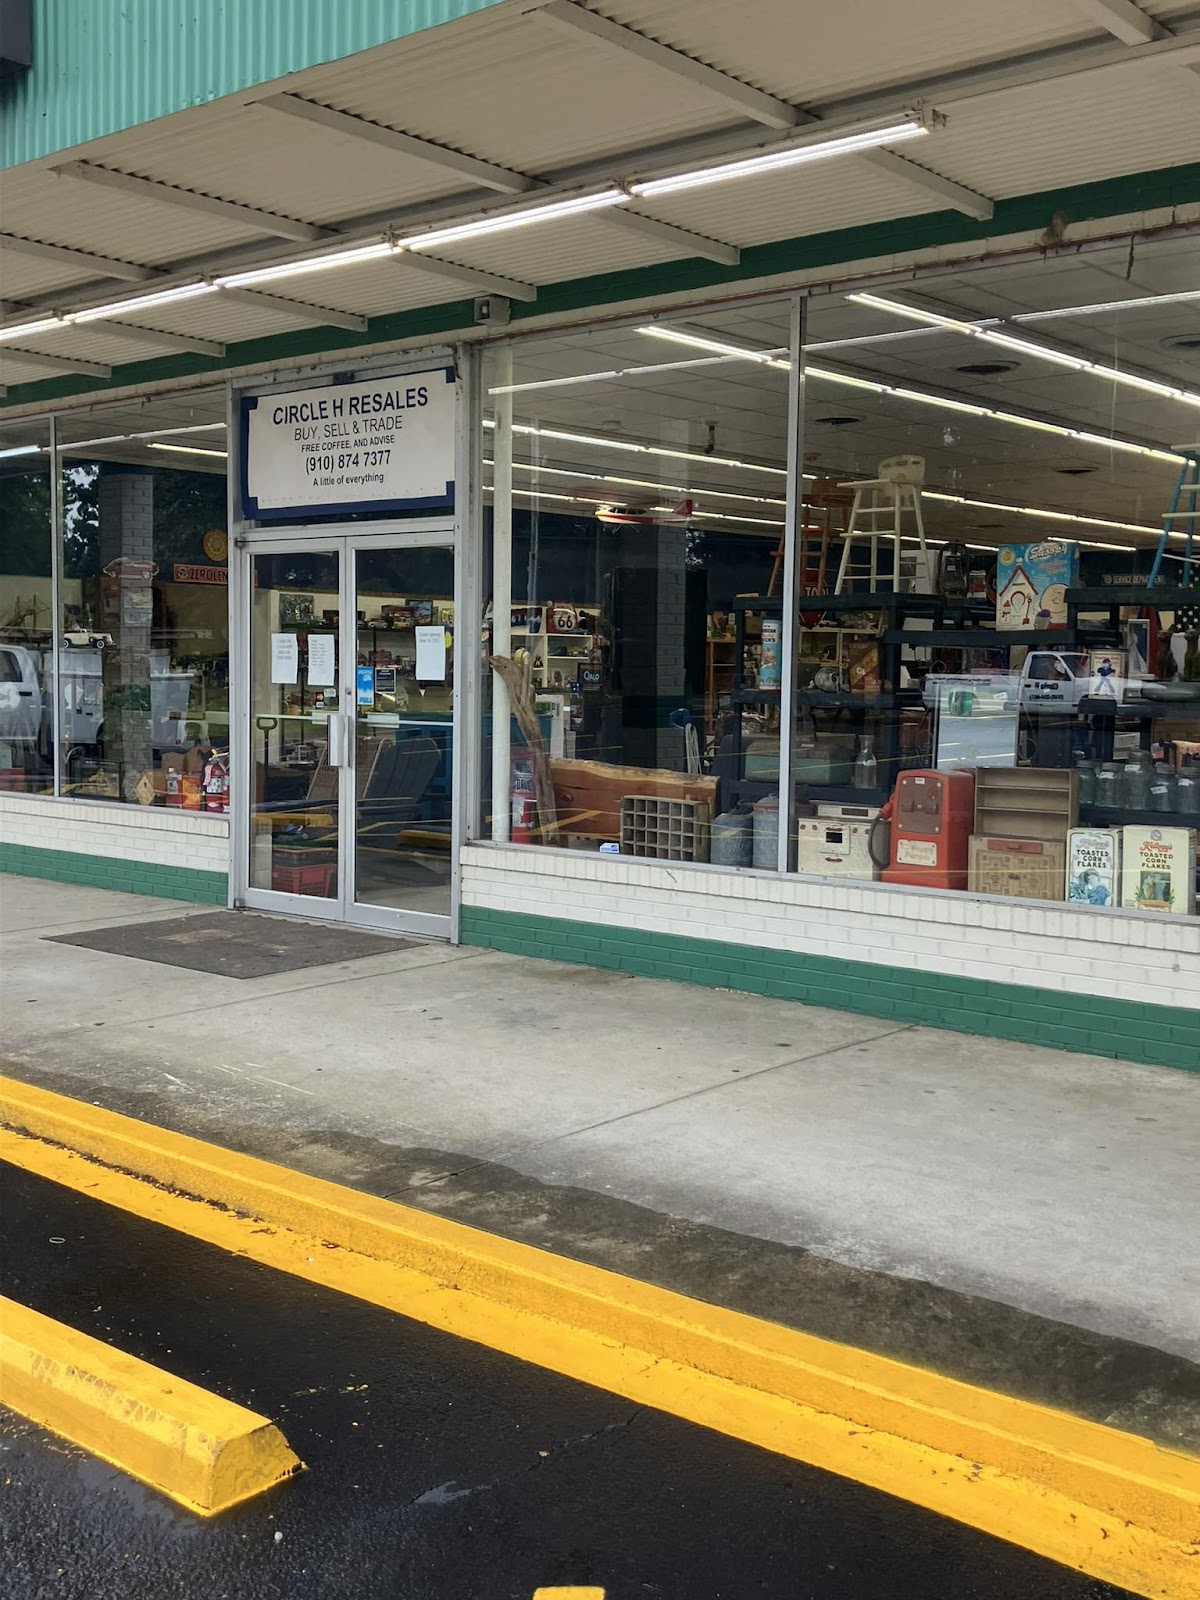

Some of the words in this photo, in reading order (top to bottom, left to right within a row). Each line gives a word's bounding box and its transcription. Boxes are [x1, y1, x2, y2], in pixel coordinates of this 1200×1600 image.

[273, 400, 329, 425] CIRCLE
[333, 398, 344, 418] H
[349, 386, 428, 416] RESALES
[294, 426, 320, 441] BUY,
[324, 422, 350, 438] SELL
[352, 420, 360, 435] &
[362, 415, 403, 433] TRADE
[301, 443, 320, 453] FREE
[321, 440, 352, 451] COFFEE,
[353, 438, 368, 448] AND
[369, 434, 396, 446] ADVISE
[305, 455, 335, 475] (910)
[338, 453, 360, 469] 874
[363, 449, 391, 467] 7377
[313, 478, 319, 487] A
[320, 476, 335, 486] little
[336, 475, 344, 485] of
[345, 472, 385, 485] everything
[1029, 544, 1068, 560] Snoopy
[190, 568, 229, 582] ZEROLEN
[557, 615, 573, 629] 66
[1076, 849, 1109, 857] TOASTED
[1139, 851, 1174, 860] TOASTED
[1077, 860, 1107, 869] FLAKES
[1141, 862, 1171, 870] FLAKES
